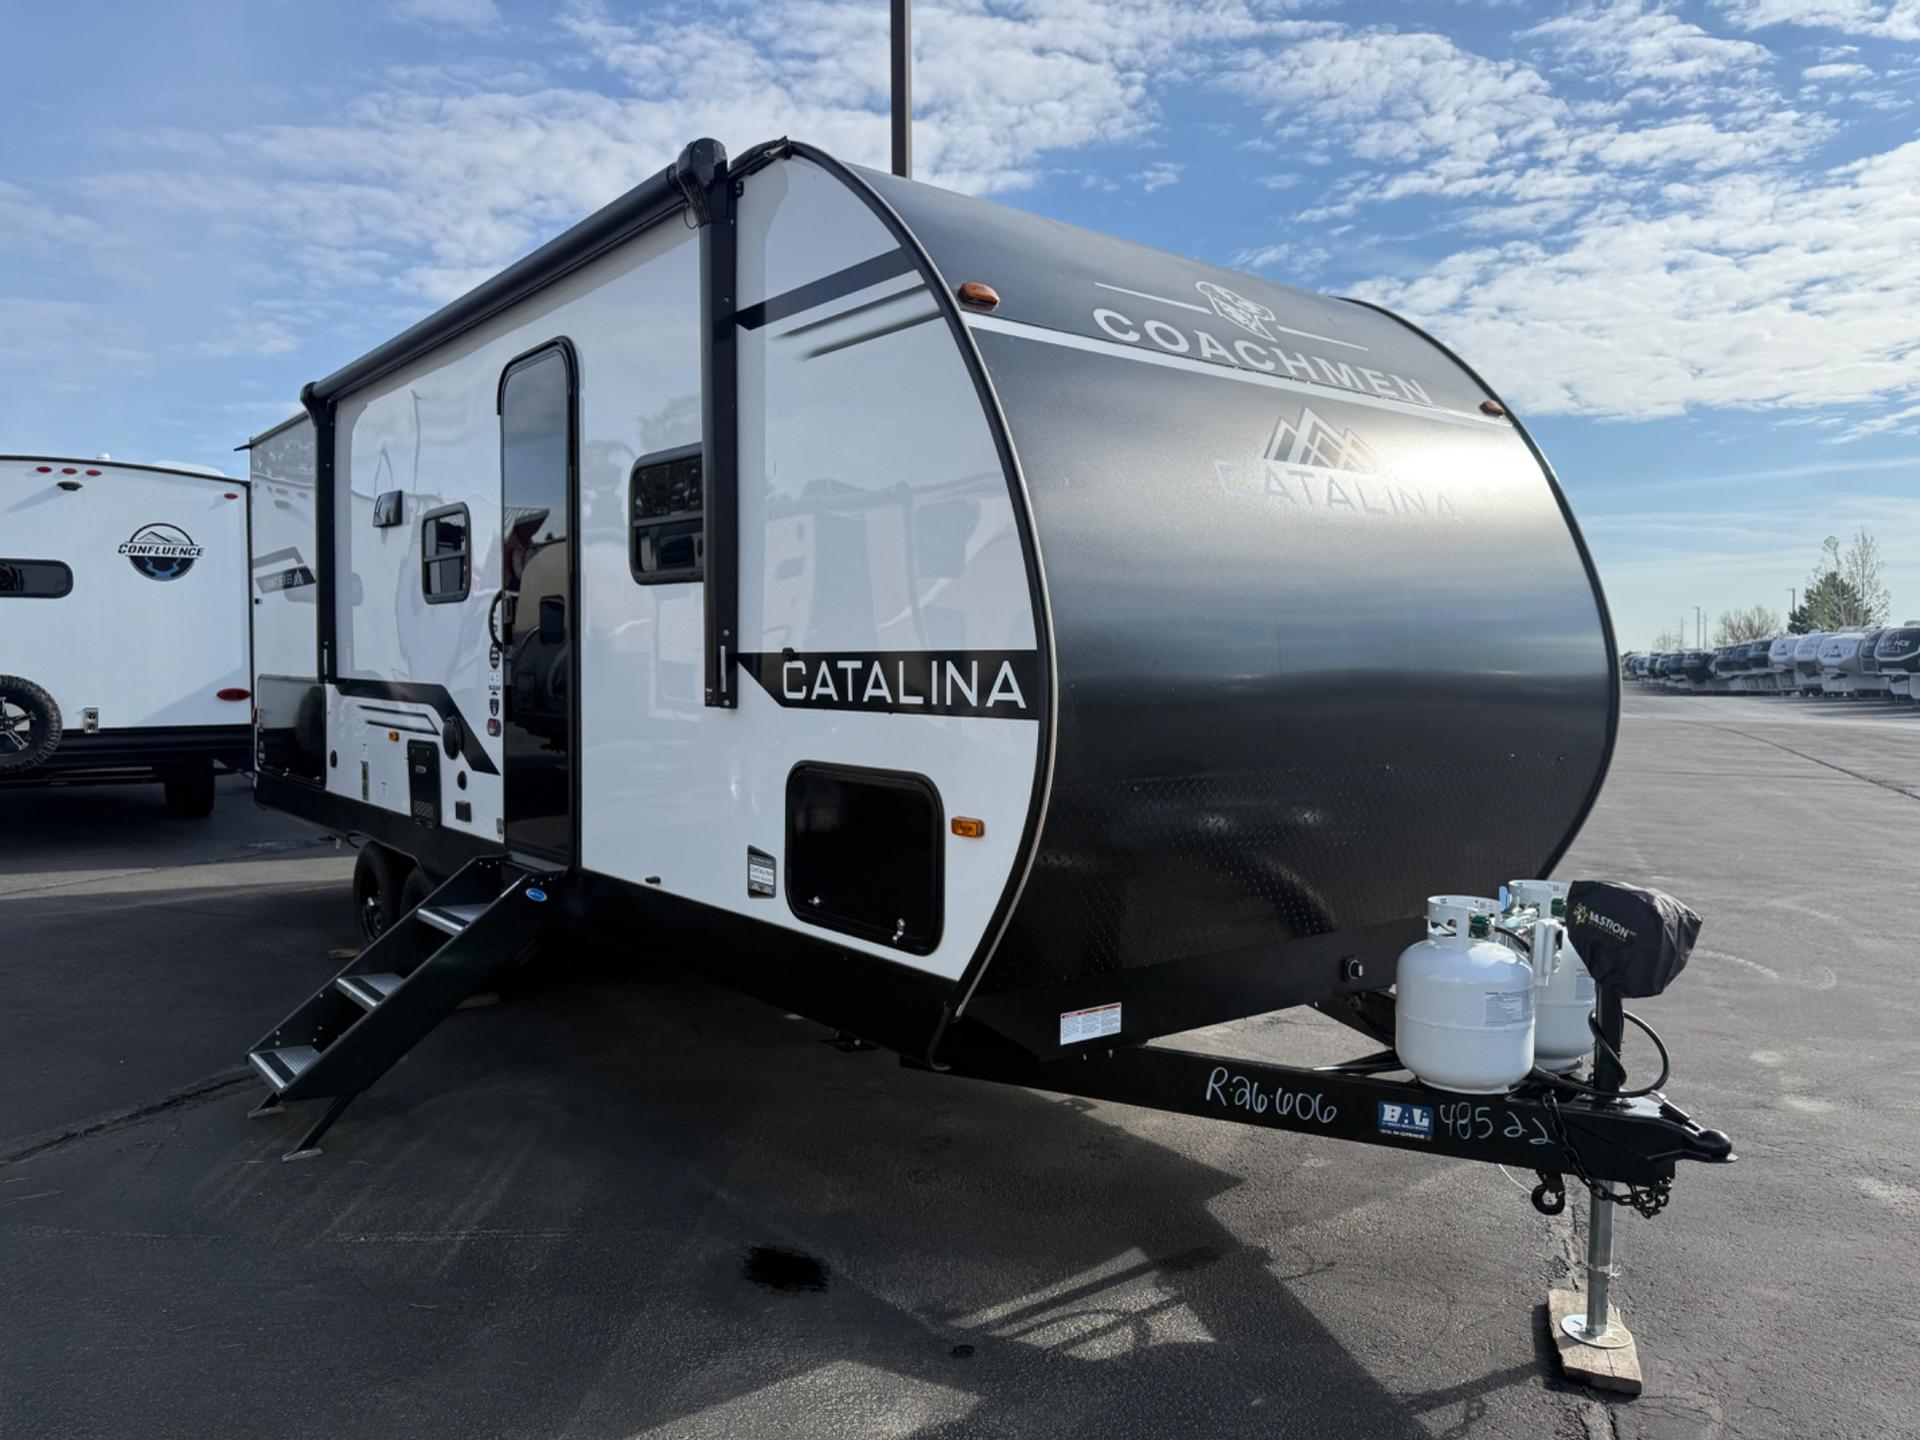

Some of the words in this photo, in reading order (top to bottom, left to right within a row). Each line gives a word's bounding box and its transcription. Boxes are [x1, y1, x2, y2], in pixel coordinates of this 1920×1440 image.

[1093, 308, 1433, 406] COACHMEN
[1214, 459, 1460, 518] CATALINA
[118, 543, 205, 557] CONFLUENCE
[782, 659, 1027, 709] CATALINA
